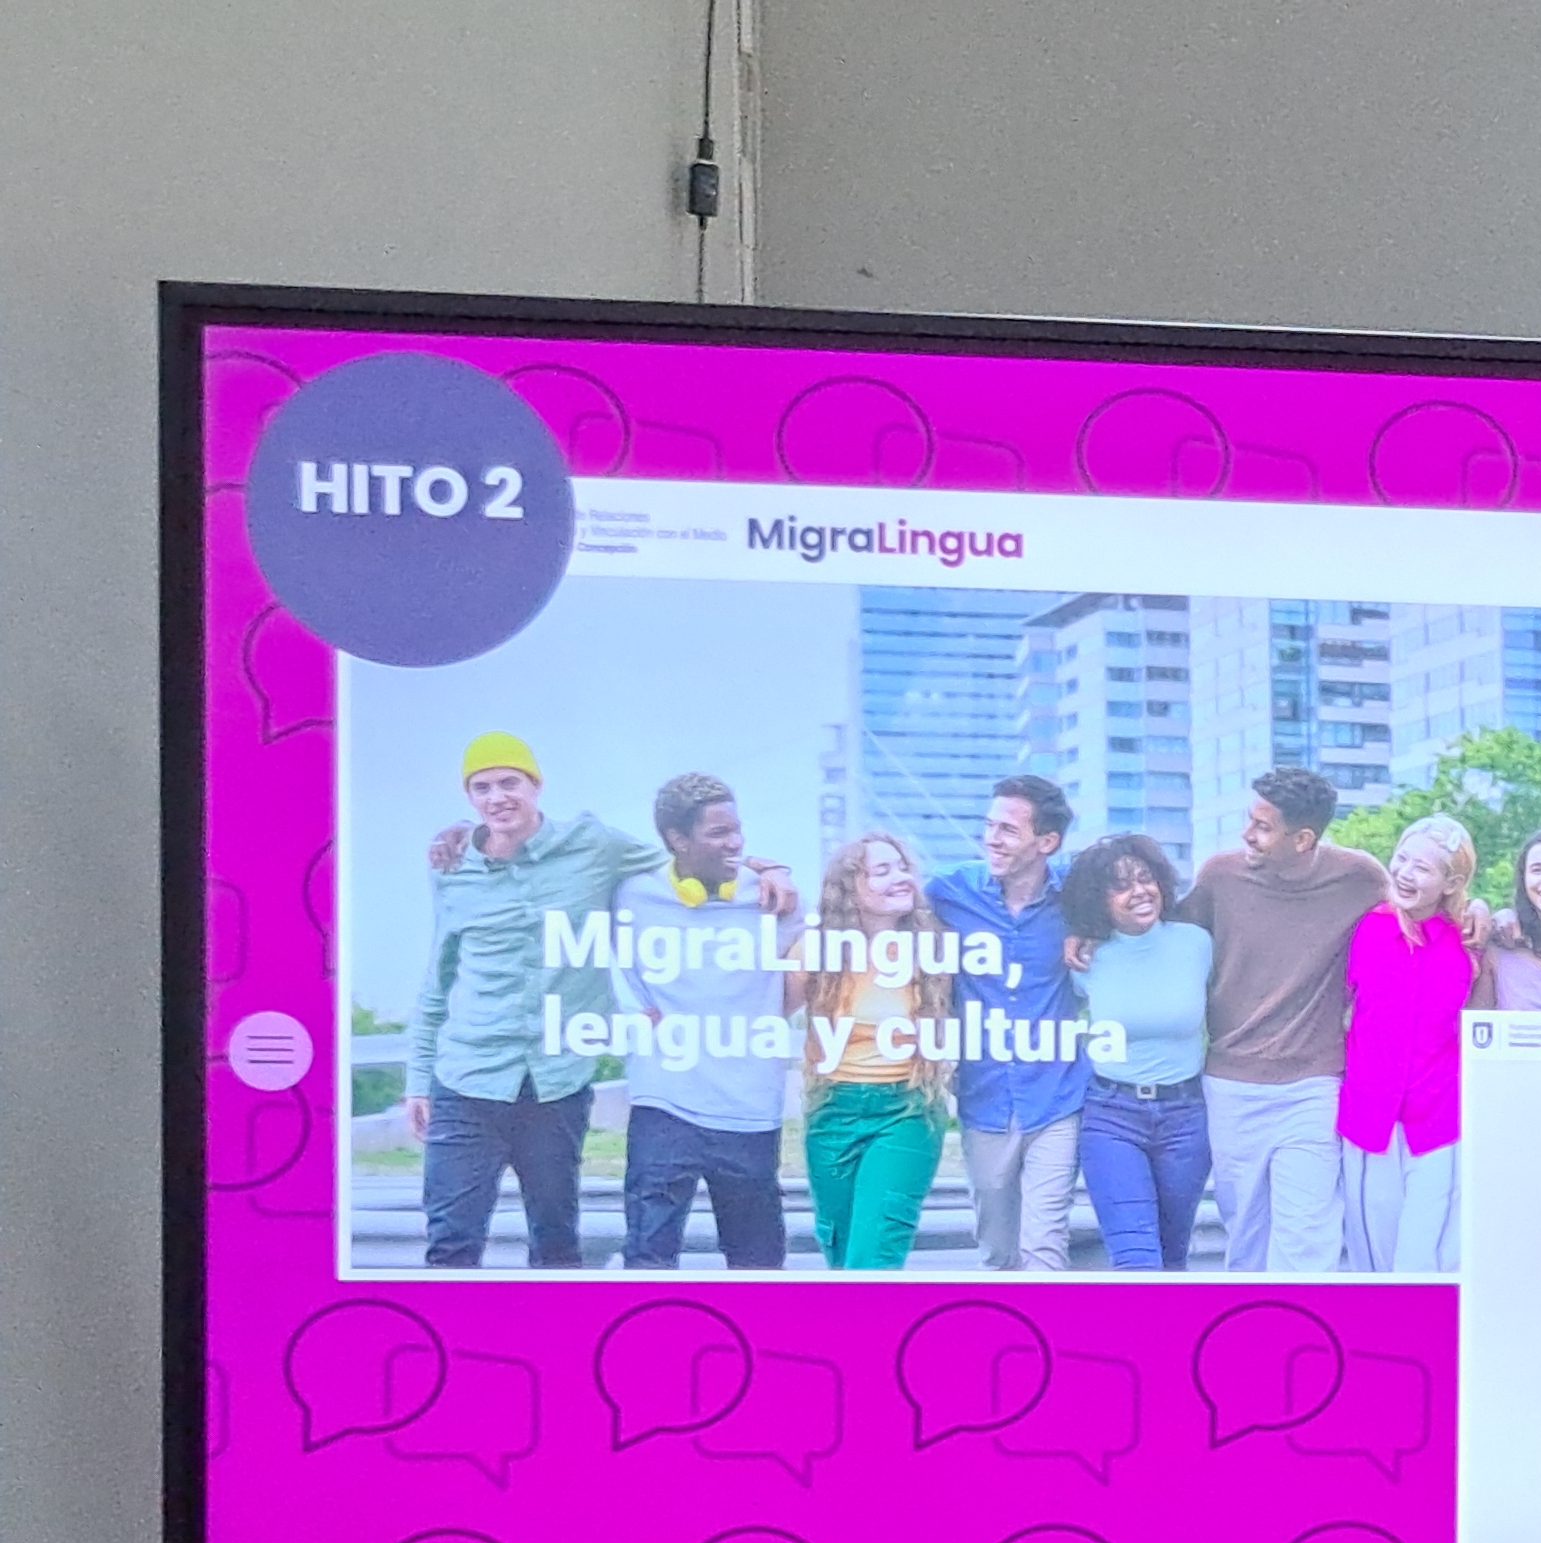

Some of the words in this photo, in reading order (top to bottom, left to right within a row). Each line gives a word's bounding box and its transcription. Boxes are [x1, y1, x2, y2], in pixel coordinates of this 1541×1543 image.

[300, 461, 469, 517] HITO
[483, 466, 524, 519] 2
[747, 515, 1024, 568] MigraLingua
[543, 908, 1023, 990] MigraLingua,
[543, 994, 794, 1072] lengua
[814, 1014, 855, 1074] y
[875, 1001, 1127, 1063] cultura
